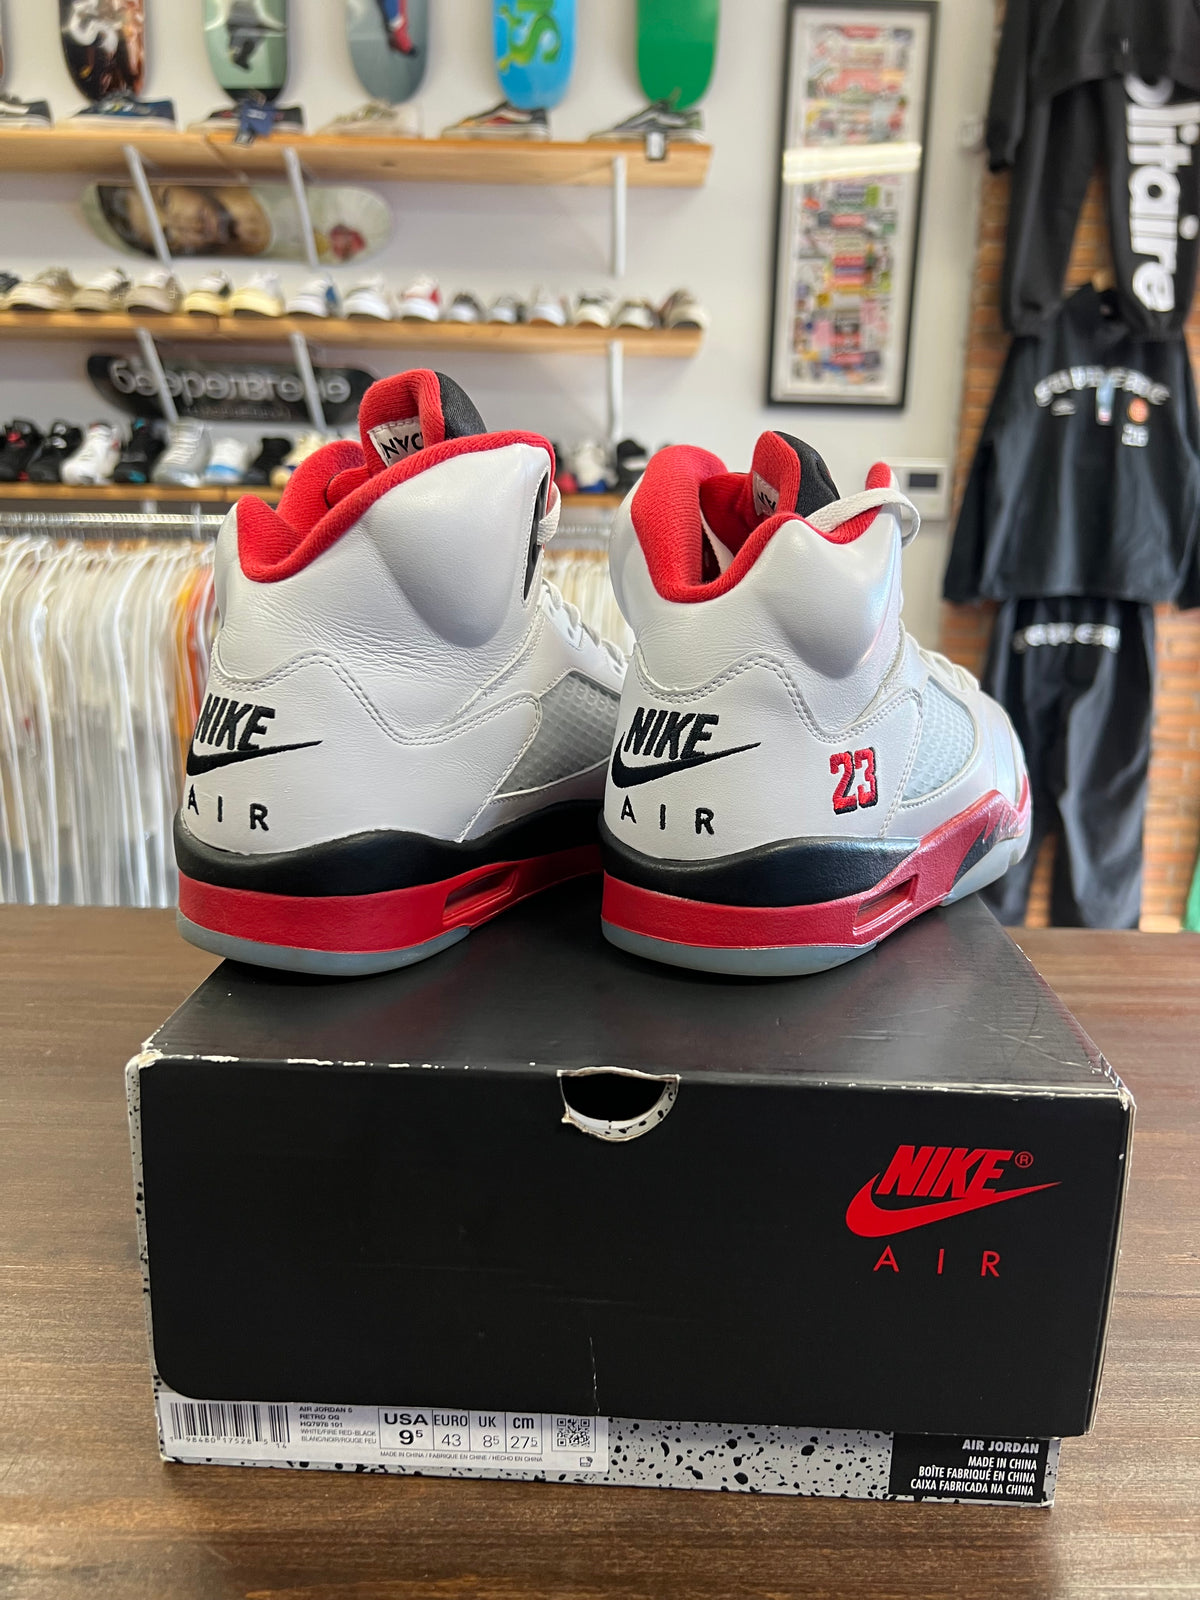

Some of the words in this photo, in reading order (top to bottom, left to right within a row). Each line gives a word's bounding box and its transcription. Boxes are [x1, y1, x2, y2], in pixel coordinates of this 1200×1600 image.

[196, 693, 276, 750] NIKE
[623, 706, 719, 760] NIKE
[830, 747, 878, 815] 23
[188, 784, 269, 831] AIR
[621, 795, 715, 835] AIR
[875, 1144, 1014, 1198] NIKE
[873, 1245, 1000, 1277] AIR
[384, 1413, 429, 1426] USA
[434, 1414, 468, 1427] EURO
[478, 1416, 497, 1428] UK
[513, 1417, 534, 1429] cm
[441, 1434, 462, 1446] 43
[962, 1439, 984, 1450] AIR
[988, 1441, 1039, 1454] JORDAN
[968, 1456, 994, 1468] MADE
[997, 1458, 1006, 1468] IN
[1009, 1459, 1037, 1470] CHINA
[919, 1465, 944, 1478] BOÎTE
[947, 1468, 991, 1480] FABRIQUÉ
[994, 1471, 1005, 1481] EN
[1008, 1472, 1035, 1483] CHINA
[910, 1479, 936, 1490] CAIXA
[939, 1480, 988, 1493] FABRICADA
[991, 1483, 1003, 1494] NA
[1006, 1484, 1033, 1496] CHINA
